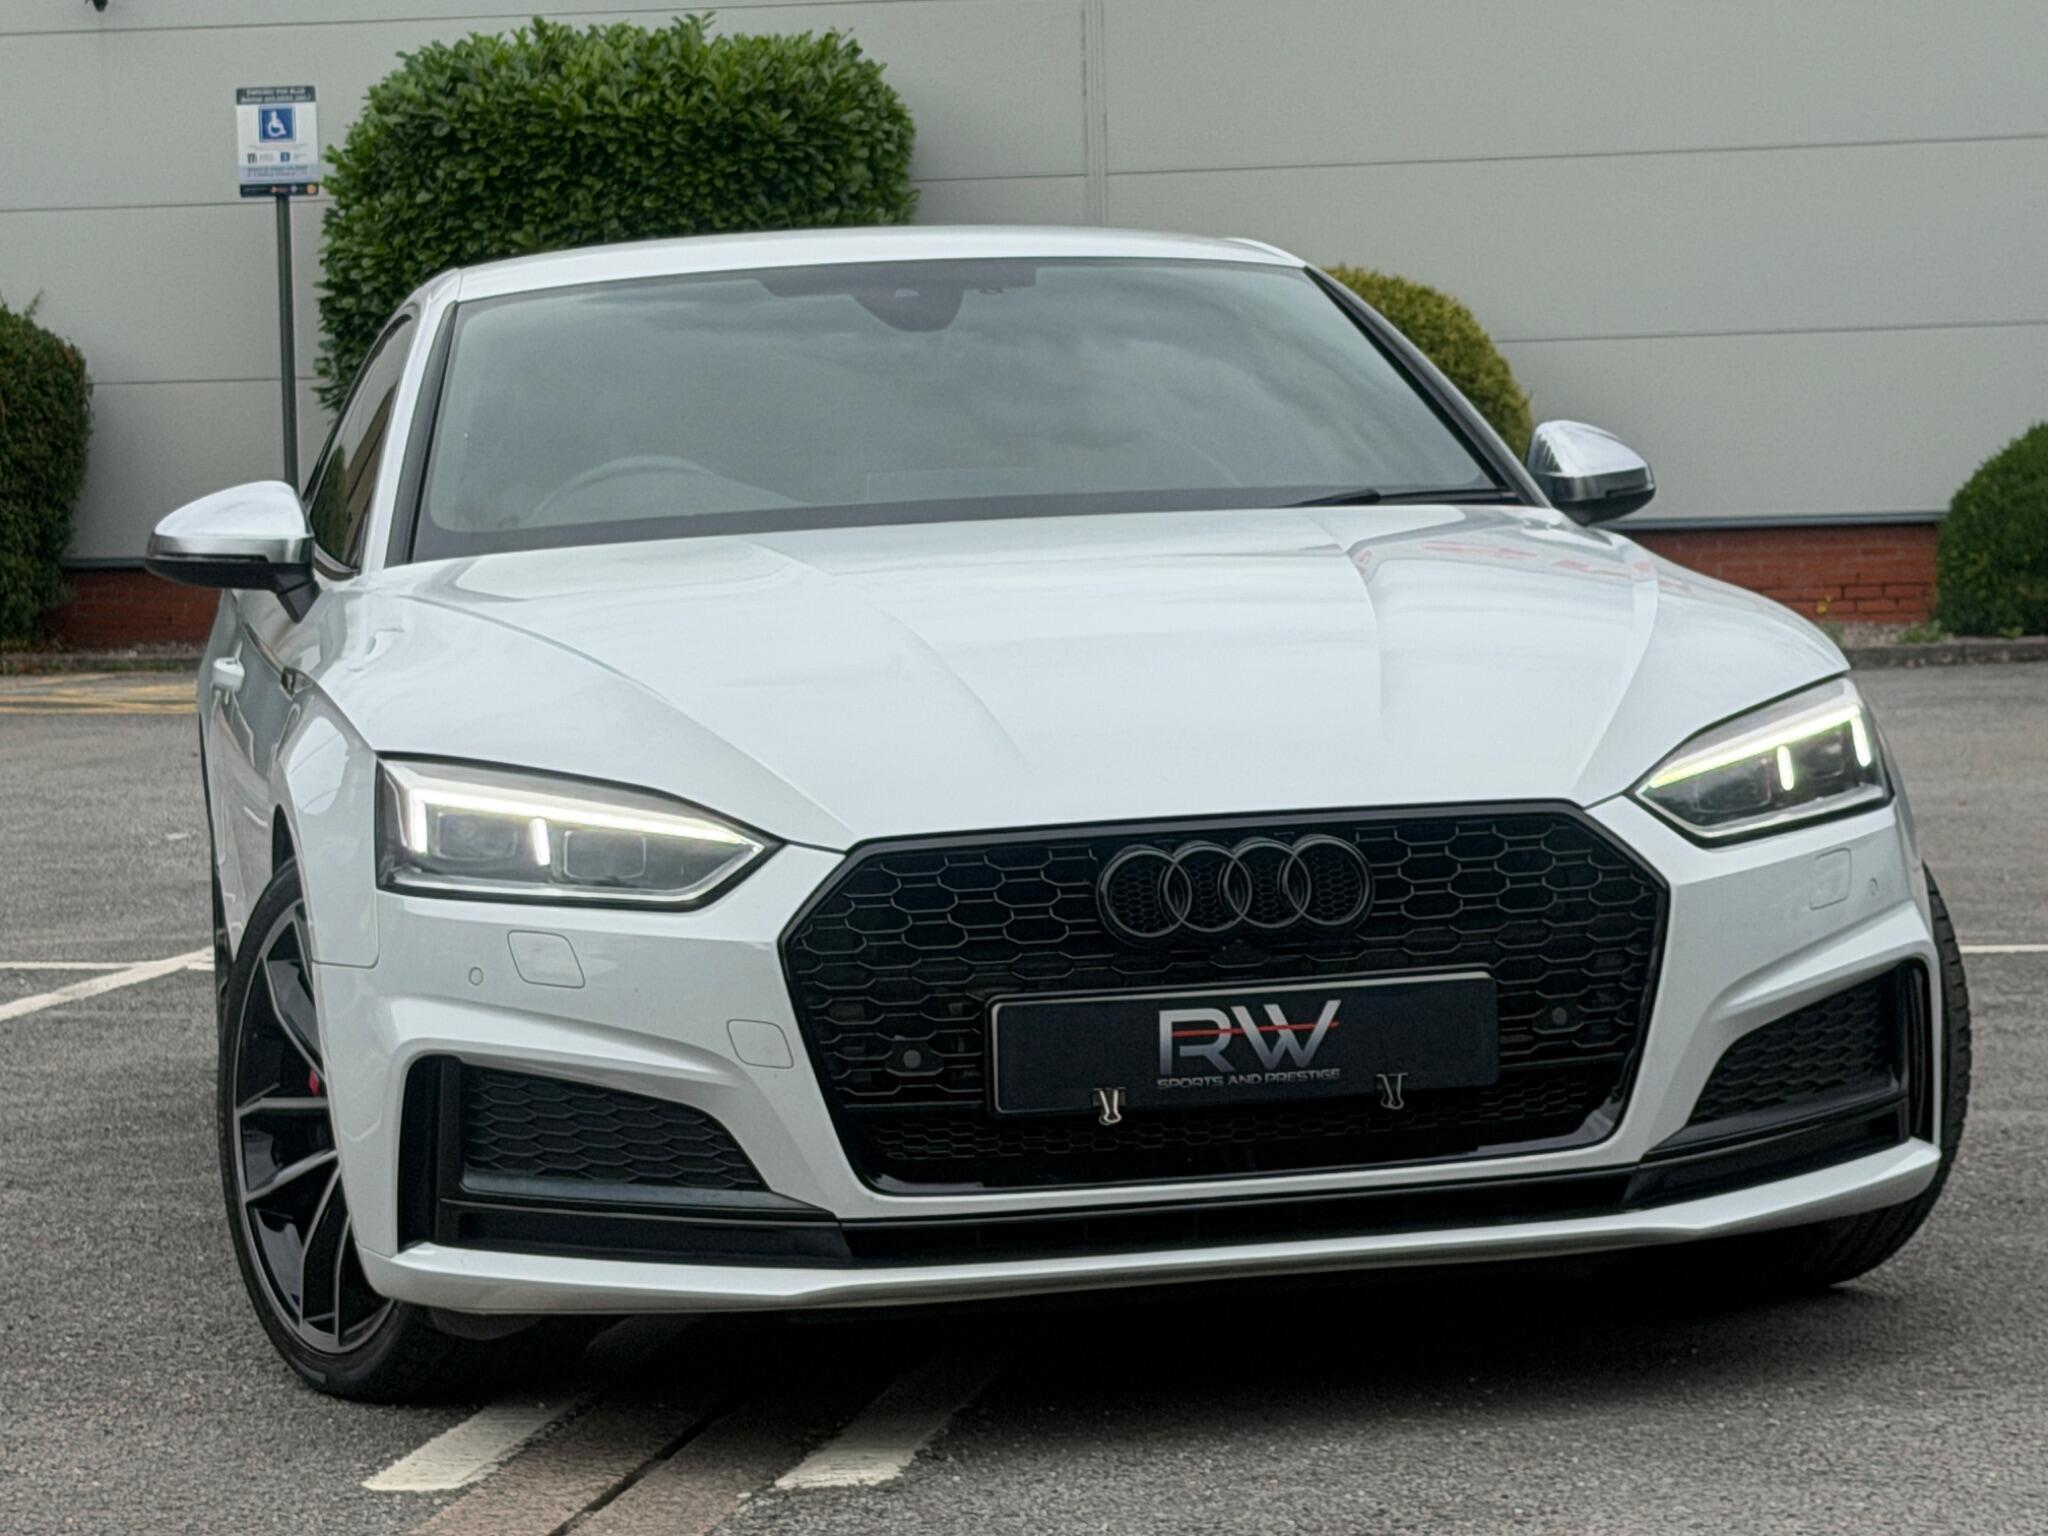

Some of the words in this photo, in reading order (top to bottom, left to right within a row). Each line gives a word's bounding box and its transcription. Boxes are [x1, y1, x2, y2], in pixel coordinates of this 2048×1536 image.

[1159, 1000, 1342, 1076] RW
[1157, 1076, 1224, 1089] SPORTS
[1227, 1073, 1262, 1086] AND
[1264, 1068, 1342, 1083] PRESTIGE
